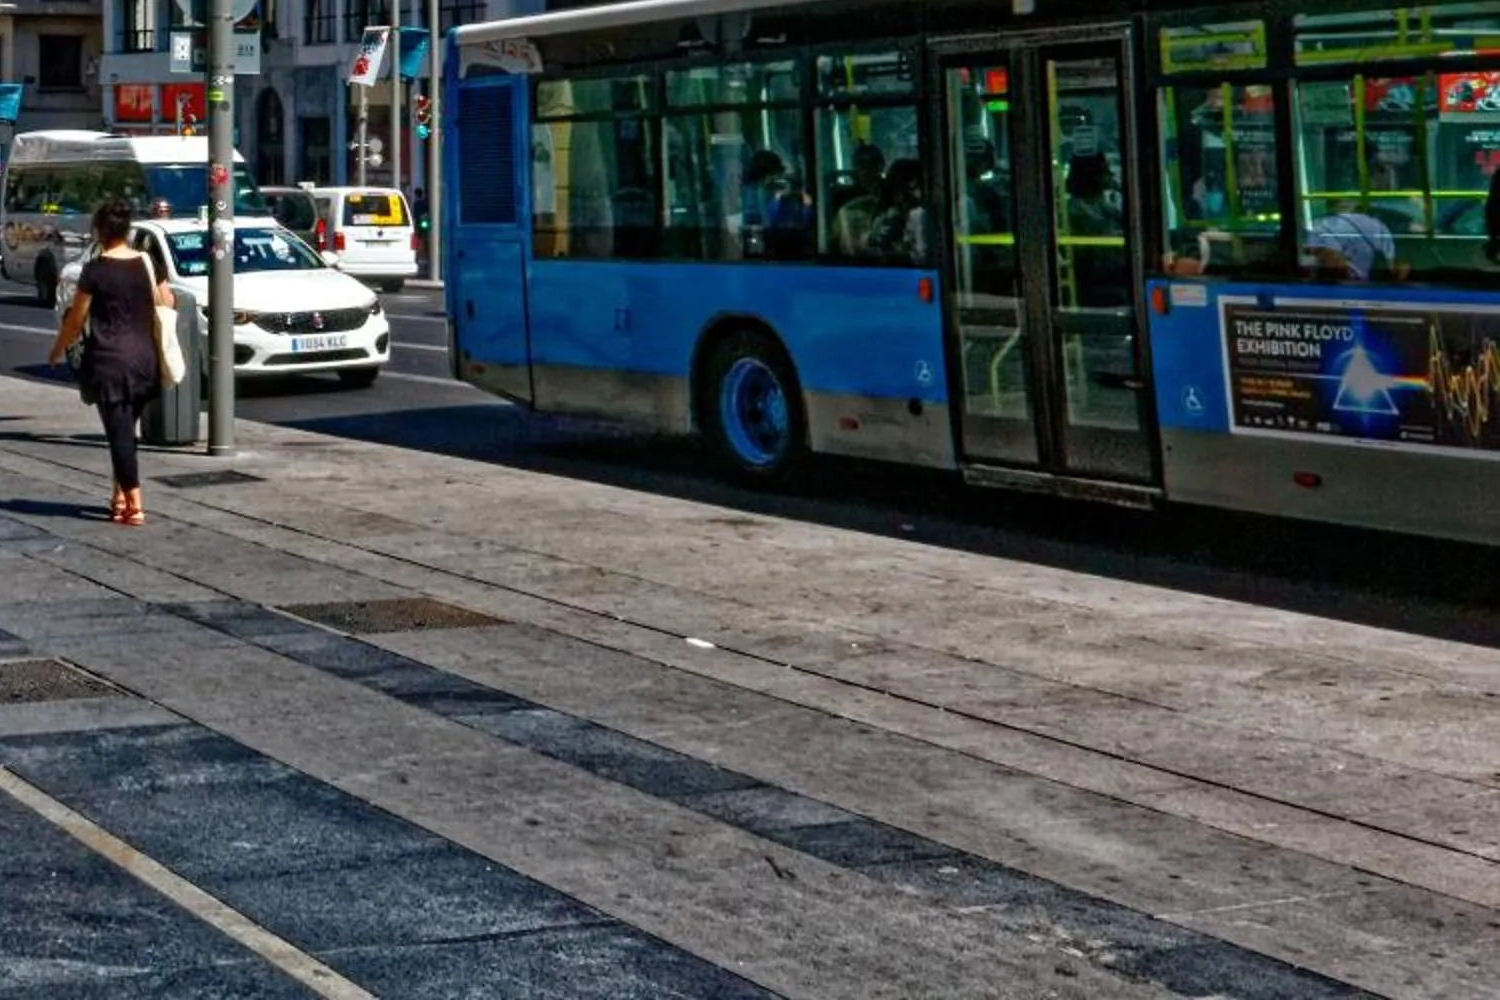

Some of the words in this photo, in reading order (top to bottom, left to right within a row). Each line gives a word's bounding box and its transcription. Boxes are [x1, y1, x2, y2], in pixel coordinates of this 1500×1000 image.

[1235, 320, 1263, 336] THE
[1265, 322, 1301, 338] PINK
[1303, 324, 1354, 341] FLOYD
[1237, 338, 1321, 357] EXHIBITION
